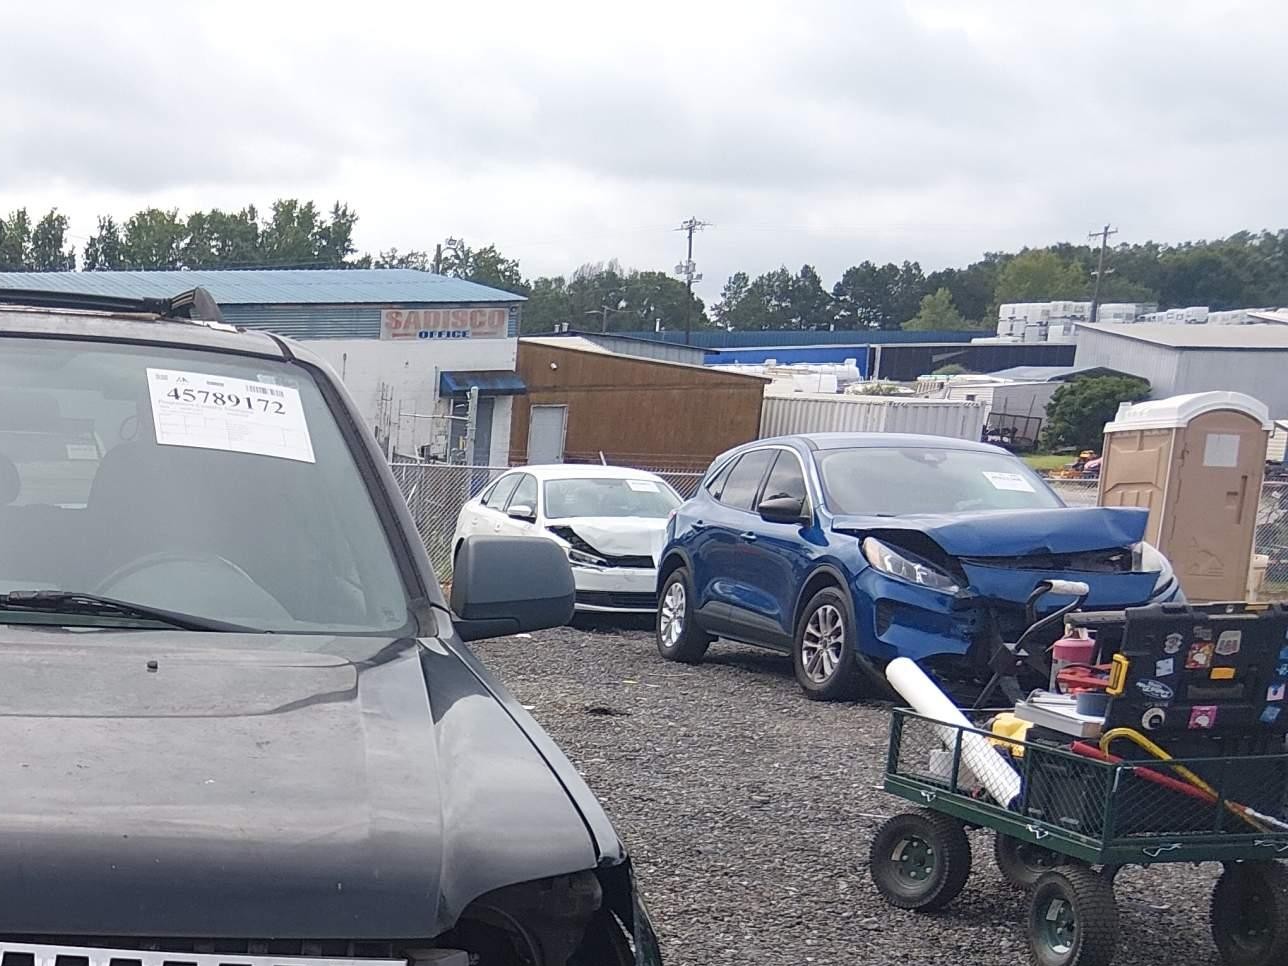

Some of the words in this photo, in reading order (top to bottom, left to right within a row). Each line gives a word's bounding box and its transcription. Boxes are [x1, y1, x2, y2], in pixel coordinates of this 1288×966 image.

[385, 310, 505, 330] SADISCO
[418, 330, 471, 339] OFFICE
[167, 387, 286, 415] 45789172
